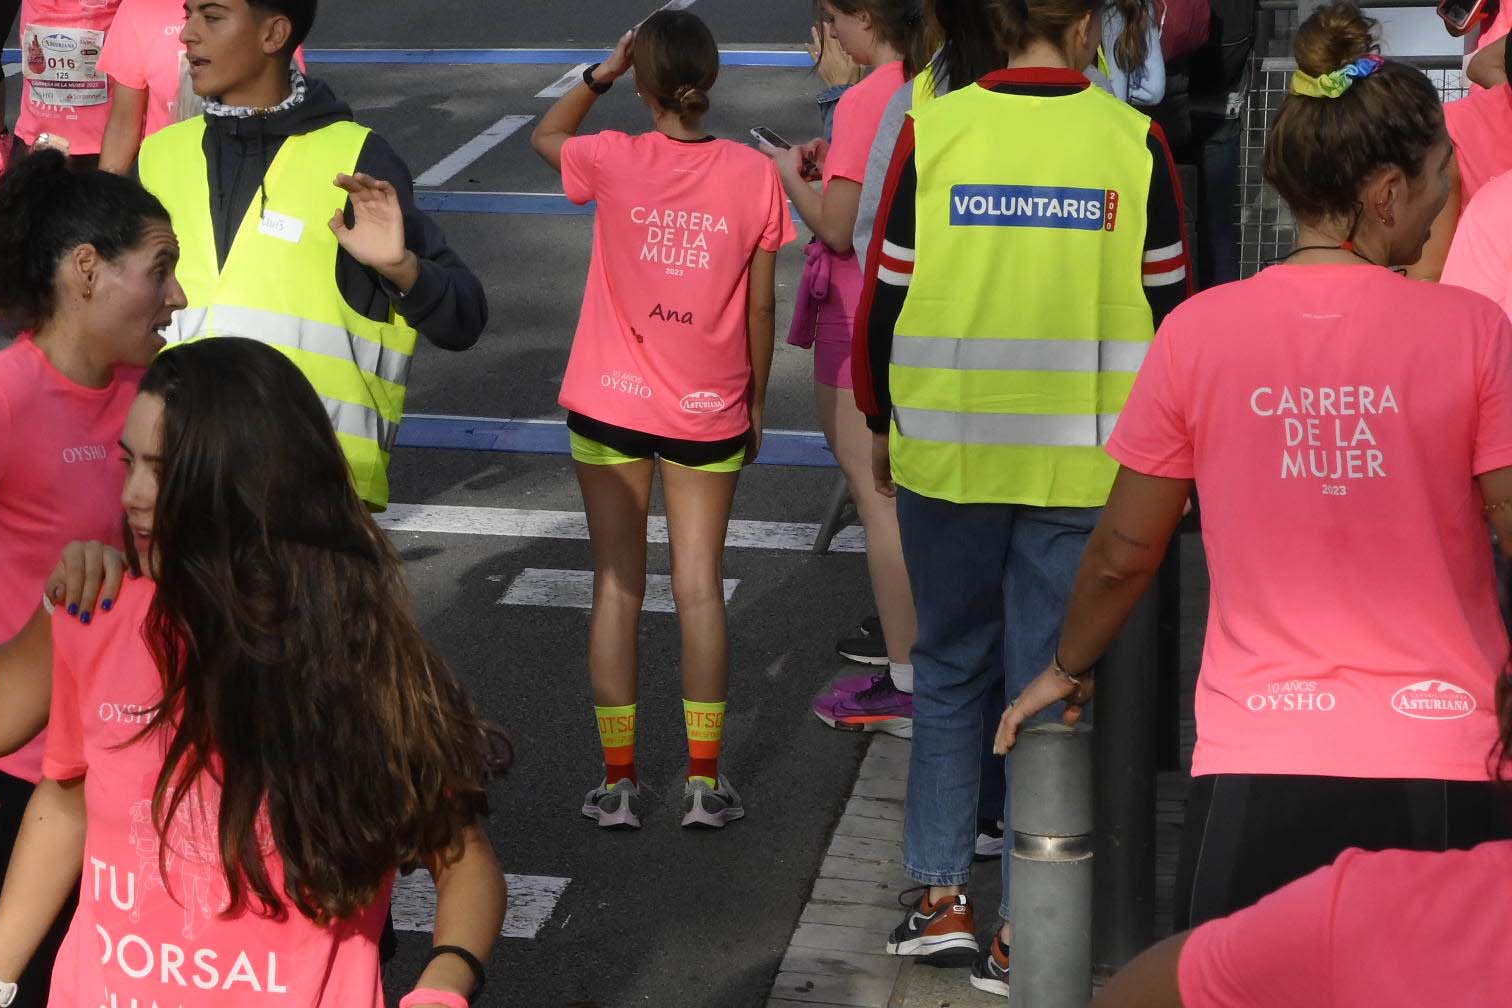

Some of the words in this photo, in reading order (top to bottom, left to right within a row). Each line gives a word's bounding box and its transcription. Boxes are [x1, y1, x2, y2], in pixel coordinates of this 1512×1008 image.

[47, 58, 76, 69] 016
[55, 72, 69, 80] 125
[954, 195, 1101, 220] VOLUNTARIS
[630, 206, 729, 234] CARRERA
[647, 226, 676, 246] DE
[682, 230, 708, 250] LA
[639, 245, 710, 269] MUJER
[648, 303, 694, 325] Ana
[600, 374, 652, 400] OYSHO
[682, 399, 723, 409] ASTURIANA
[1249, 385, 1399, 415] CARRERA
[1285, 417, 1321, 447] DE
[1336, 417, 1377, 447] LA
[62, 445, 107, 464] OYSHO
[1280, 450, 1387, 479] MUJER
[1322, 484, 1347, 496] 2023
[1282, 680, 1317, 692] AÑOS
[1247, 692, 1336, 711] OYSHO
[1397, 695, 1470, 711] ASTURIANA
[90, 856, 136, 911] TU
